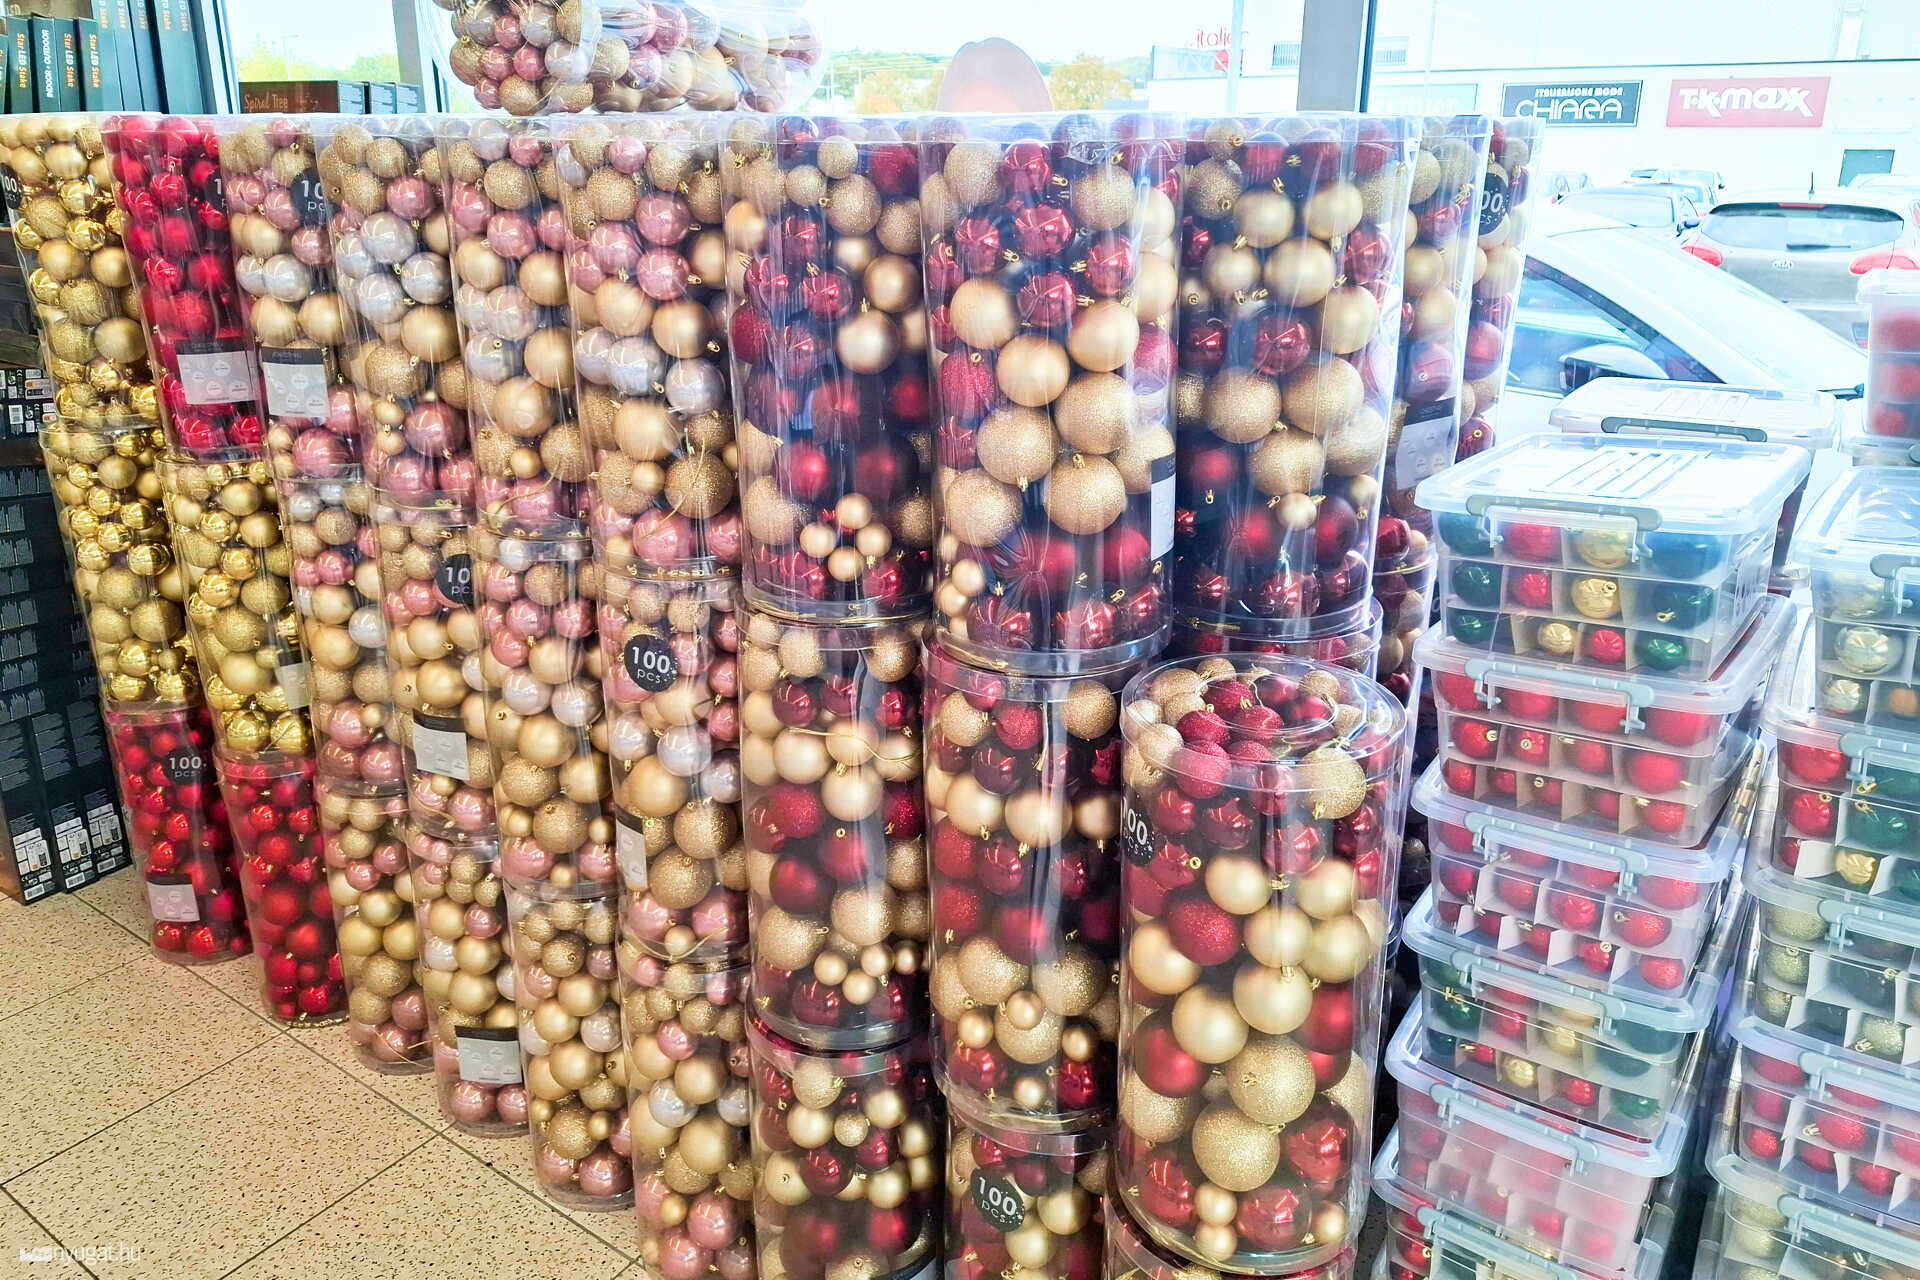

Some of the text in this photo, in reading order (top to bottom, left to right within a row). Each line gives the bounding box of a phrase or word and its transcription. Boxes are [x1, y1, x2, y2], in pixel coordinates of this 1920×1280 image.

[1515, 98, 1623, 120] CHIARA
[301, 180, 324, 200] 10
[307, 201, 326, 212] pc
[1481, 190, 1503, 213] 00
[445, 566, 471, 584] 10
[451, 585, 471, 596] pc
[631, 646, 671, 674] 100
[637, 668, 661, 684] pcs
[169, 756, 202, 770] 100
[979, 1176, 1017, 1216] 100
[982, 1199, 1007, 1223] pcs
